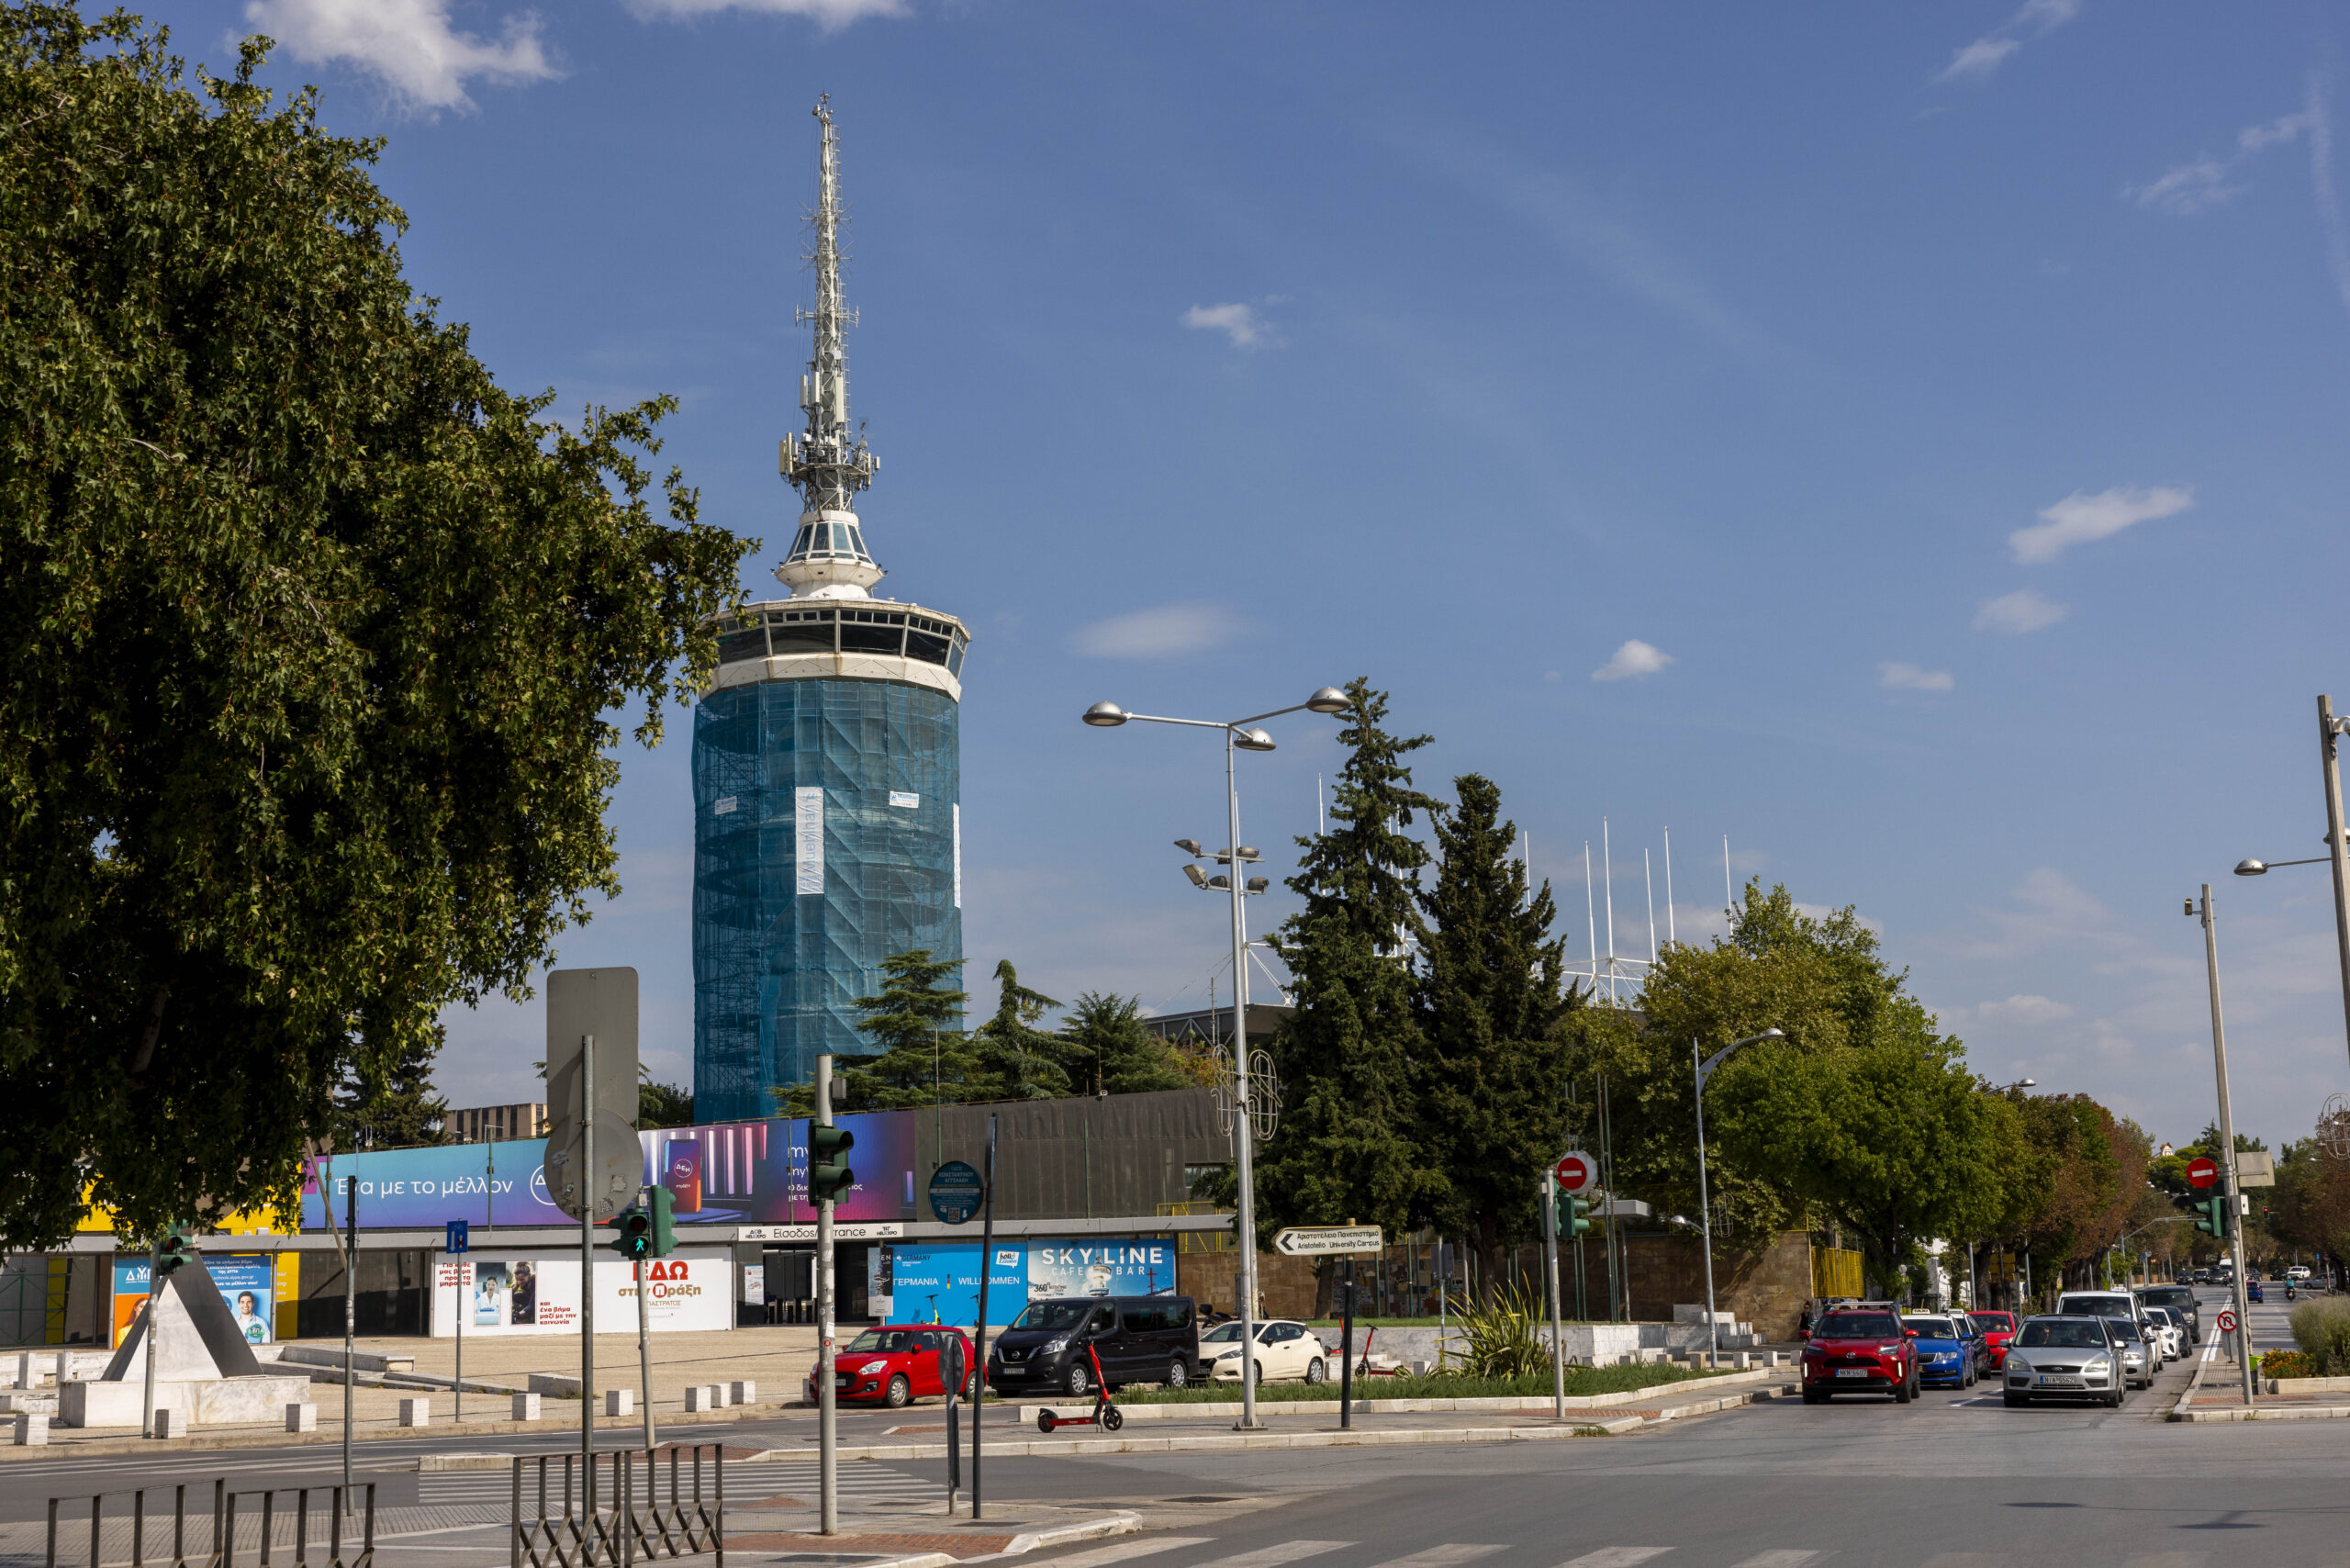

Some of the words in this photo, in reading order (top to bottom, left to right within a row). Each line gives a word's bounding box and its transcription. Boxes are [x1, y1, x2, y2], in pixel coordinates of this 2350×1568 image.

[334, 1178, 374, 1195] Έα
[381, 1180, 405, 1199] με
[410, 1180, 435, 1194] το
[442, 1176, 513, 1198] μέλλον
[1329, 1240, 1356, 1249] University
[1357, 1239, 1380, 1248] Campus
[1042, 1247, 1163, 1265] SKYLINE
[125, 1265, 151, 1281] ΔΥ
[1051, 1267, 1084, 1276] CAFE
[1115, 1266, 1146, 1275] BAR
[893, 1277, 939, 1286] ΓΕΡΜΑΝΙΑ
[957, 1276, 1020, 1285] WILLOMMEN
